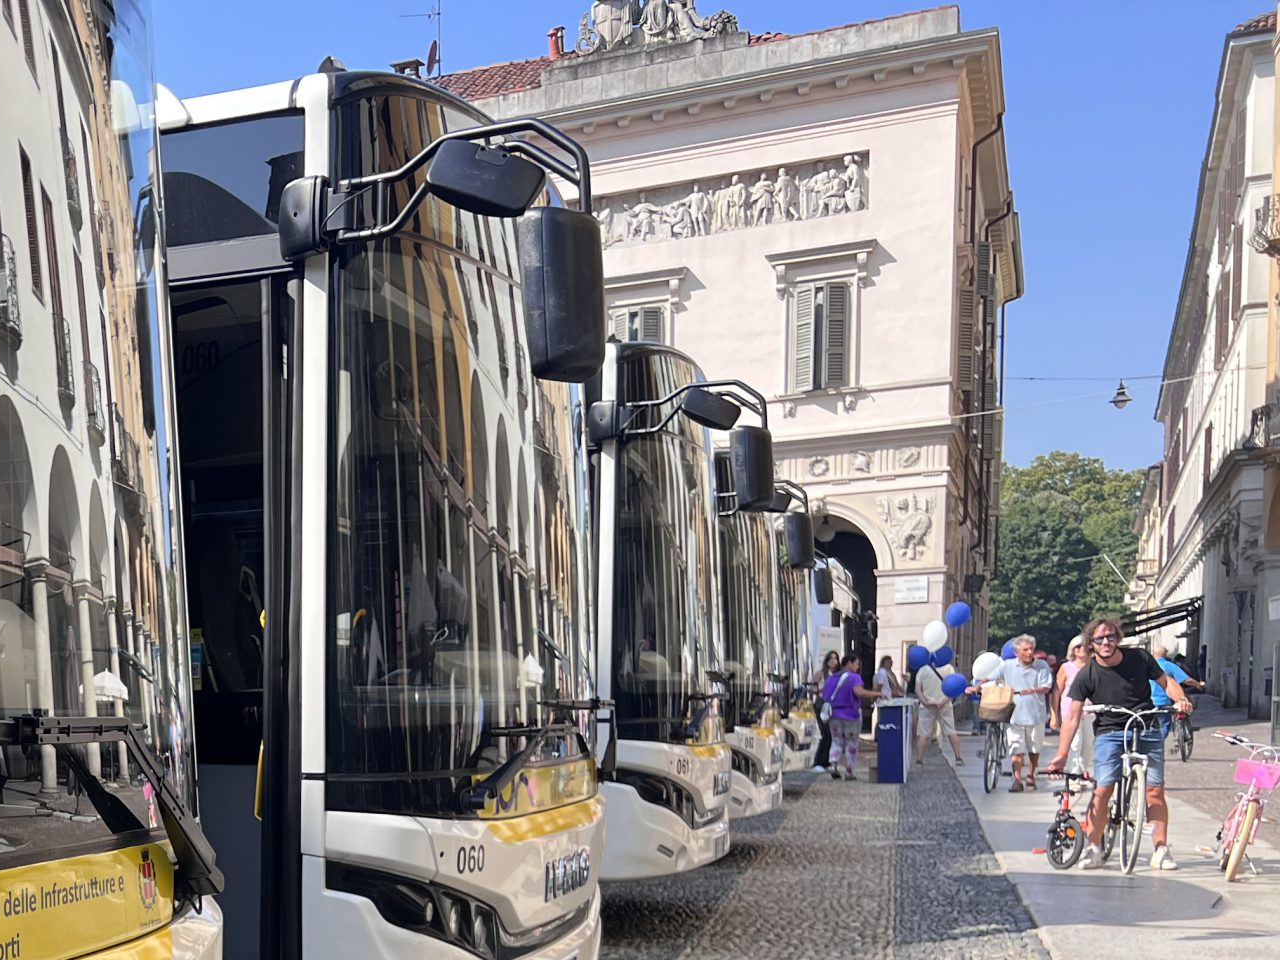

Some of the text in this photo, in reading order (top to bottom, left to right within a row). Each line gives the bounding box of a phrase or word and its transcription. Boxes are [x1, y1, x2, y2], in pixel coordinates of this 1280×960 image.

[182, 340, 220, 375] 060
[676, 756, 690, 775] 061
[456, 844, 485, 874] 060
[3, 890, 37, 918] delle
[40, 876, 116, 910] Infrastrutture
[118, 874, 125, 892] e
